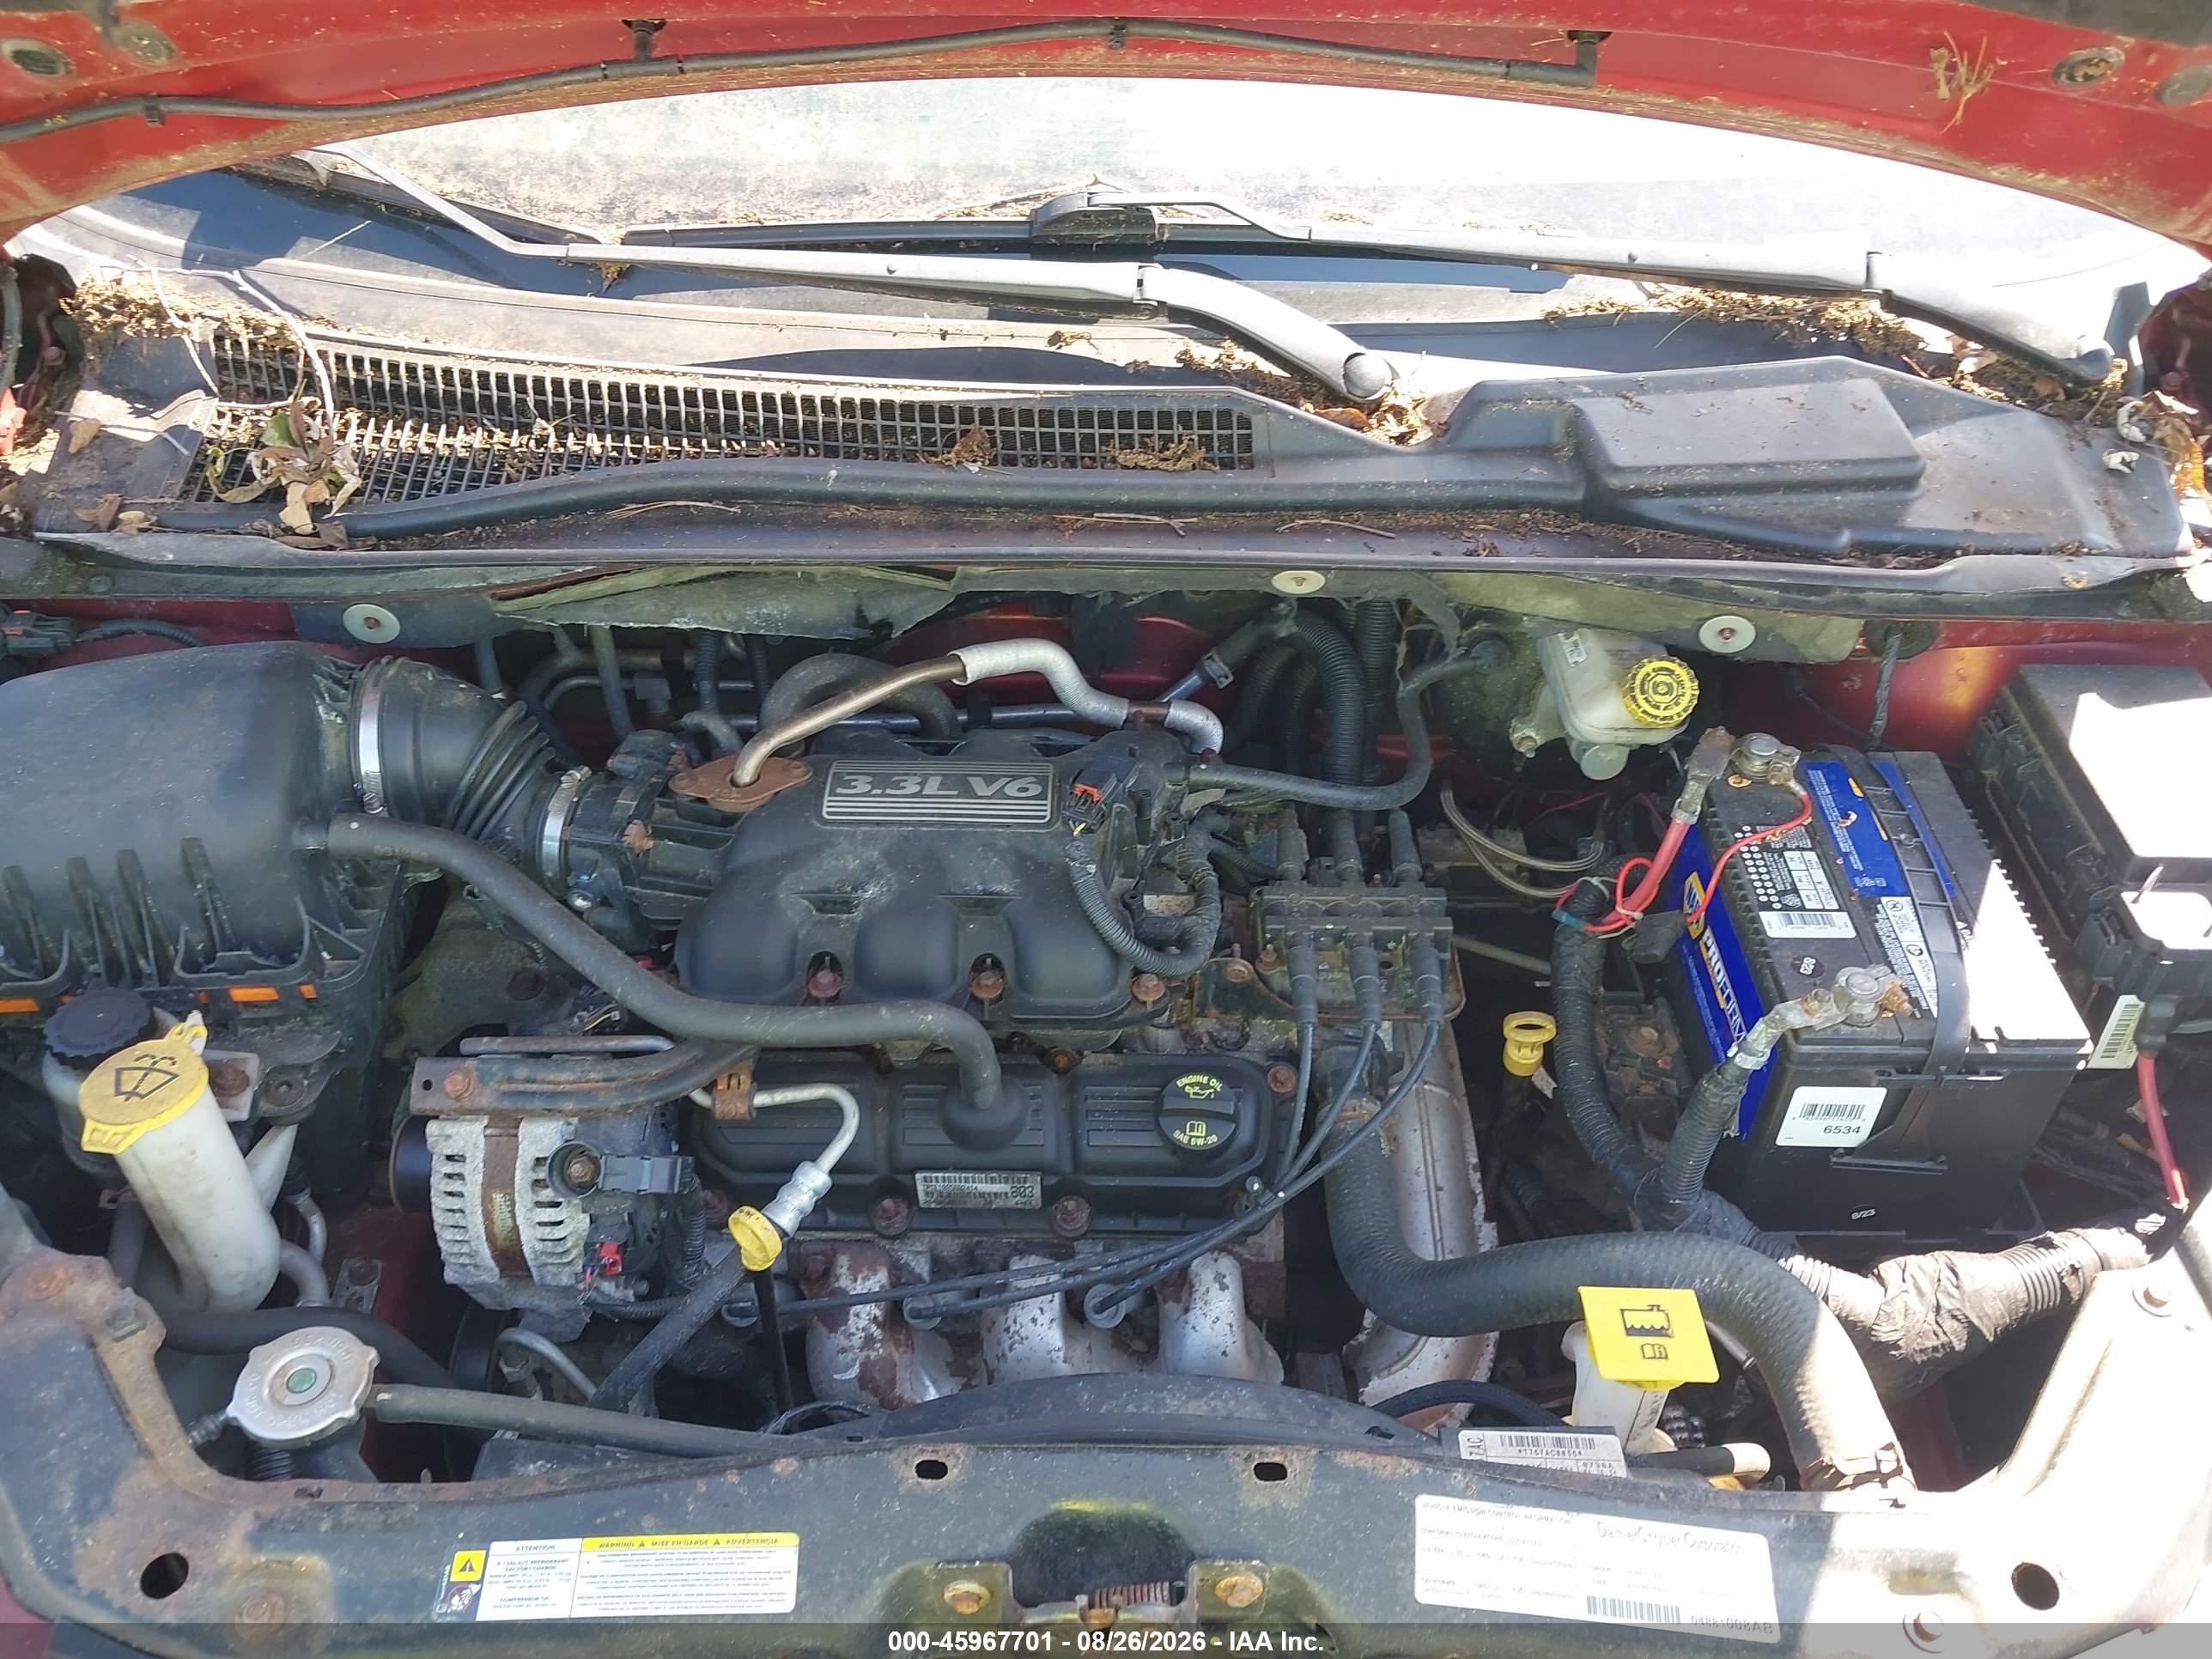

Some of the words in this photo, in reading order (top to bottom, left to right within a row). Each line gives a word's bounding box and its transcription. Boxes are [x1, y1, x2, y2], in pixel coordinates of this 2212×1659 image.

[836, 775, 959, 796] 3.3L
[967, 776, 1043, 797] V6
[1176, 1073, 1209, 1088] ENGINE
[1209, 1078, 1224, 1091] OIL
[1823, 1125, 1862, 1134] 6534
